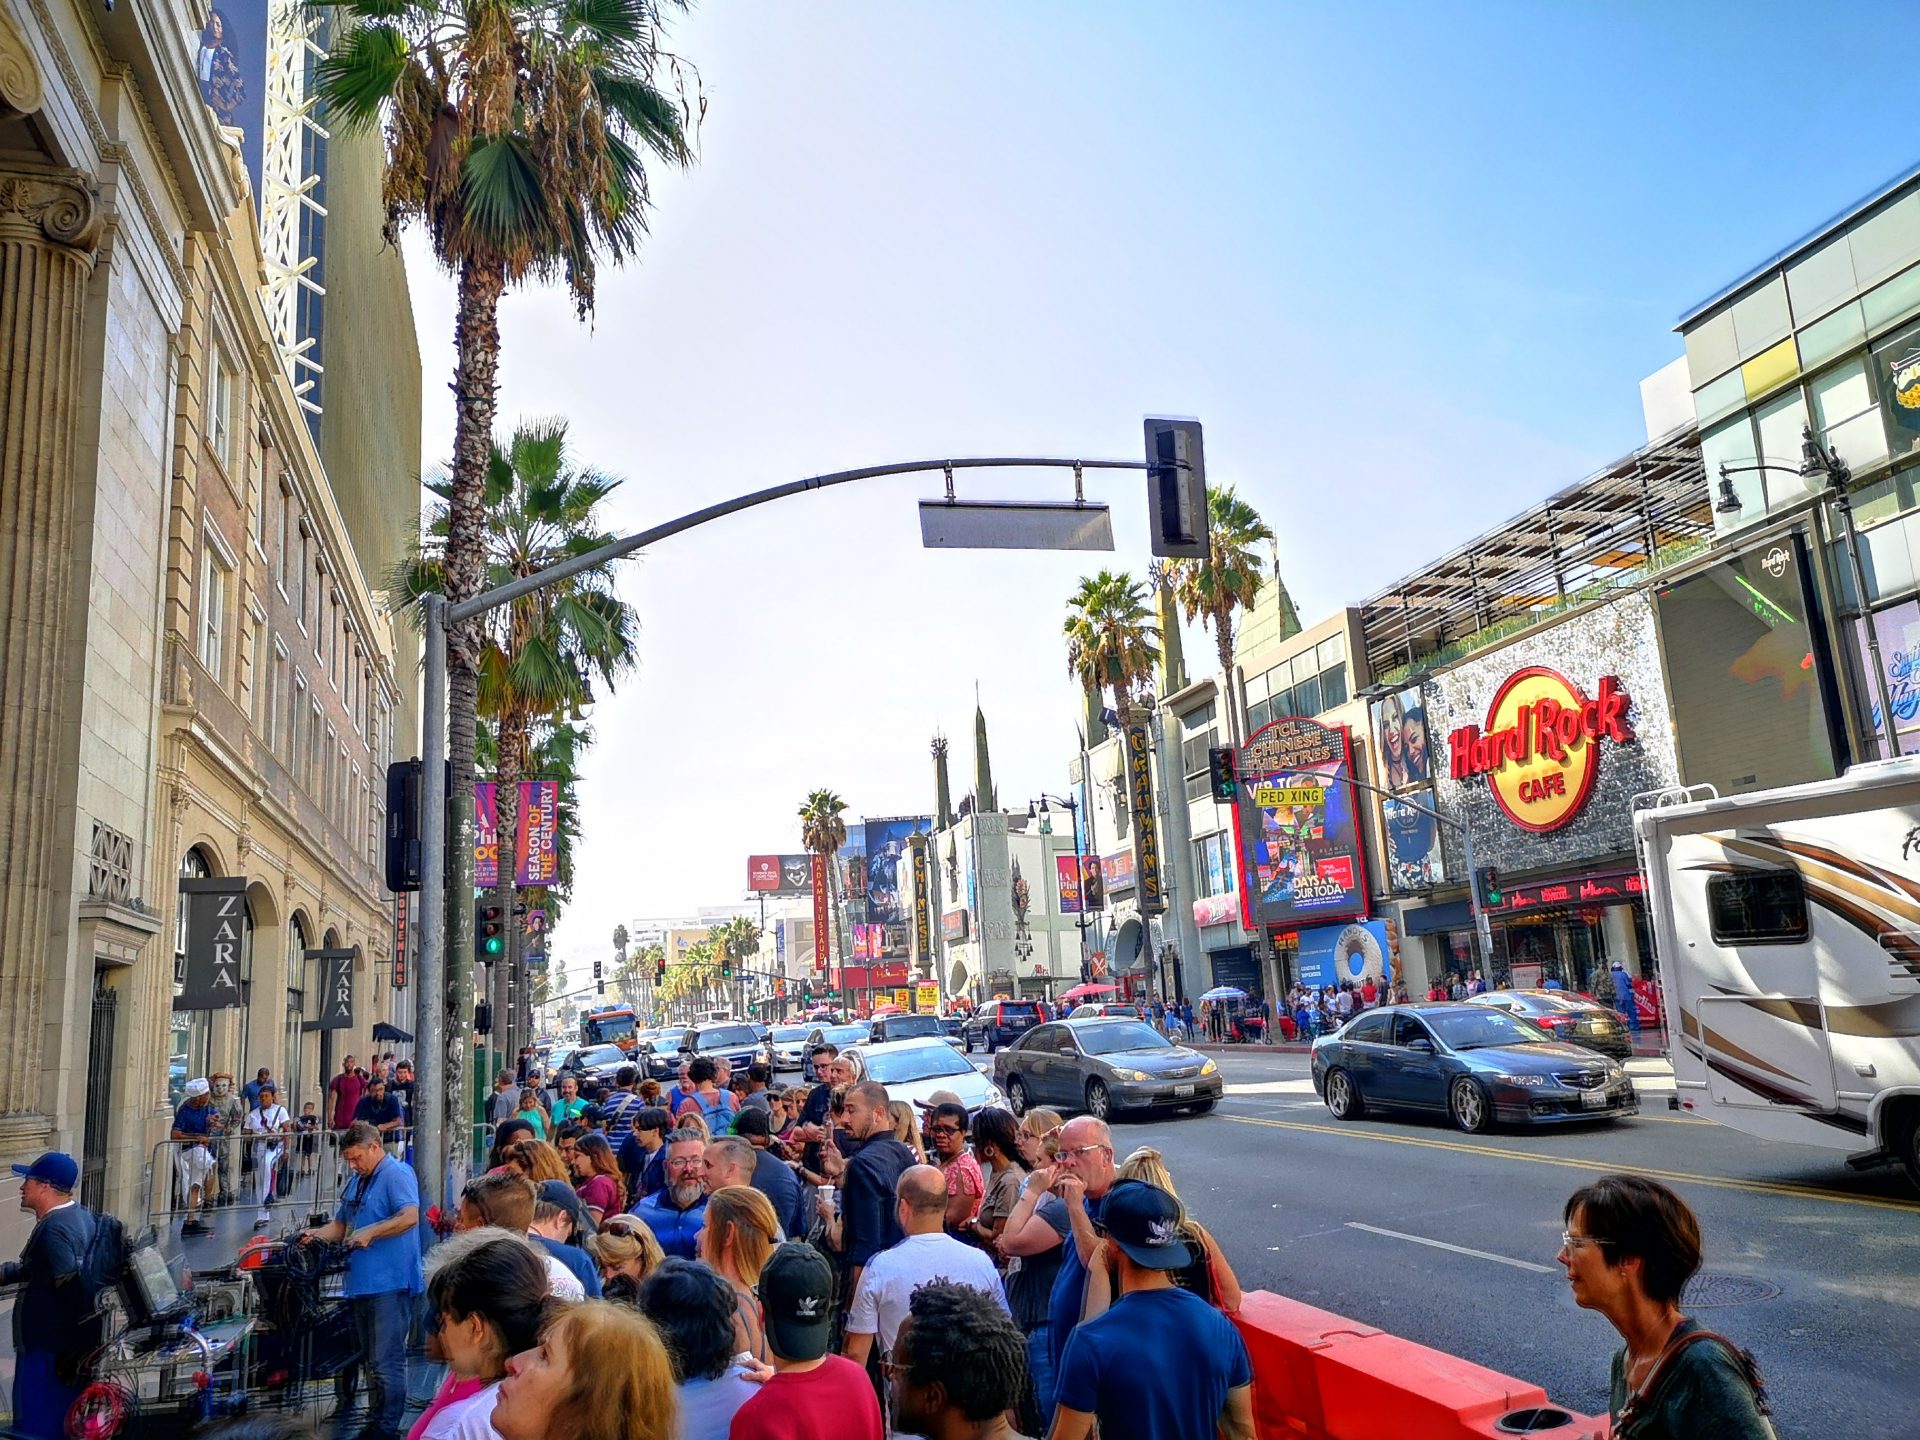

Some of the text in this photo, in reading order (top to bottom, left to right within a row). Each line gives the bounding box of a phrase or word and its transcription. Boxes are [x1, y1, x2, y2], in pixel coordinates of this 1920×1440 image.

[1269, 722, 1300, 739] TCL
[1448, 676, 1635, 779] Hard Rock
[1251, 732, 1322, 758] CHINESE
[1246, 746, 1331, 771] THEATRES
[1260, 790, 1320, 803] PED XING
[1518, 772, 1566, 804] CAFE
[1385, 808, 1406, 820] Hard
[474, 828, 497, 845] Phi
[528, 804, 540, 880] SEASON OF
[541, 787, 553, 880] THE CENTURY
[474, 846, 498, 860] 00
[815, 857, 823, 903] MADAME
[1060, 872, 1071, 880] LA
[1061, 881, 1078, 890] Phil
[1293, 875, 1319, 889] DAYS
[914, 856, 929, 953] CHINESE
[211, 895, 238, 989] ZARA
[335, 959, 352, 1017] ZARA
[898, 992, 907, 1001] 5
